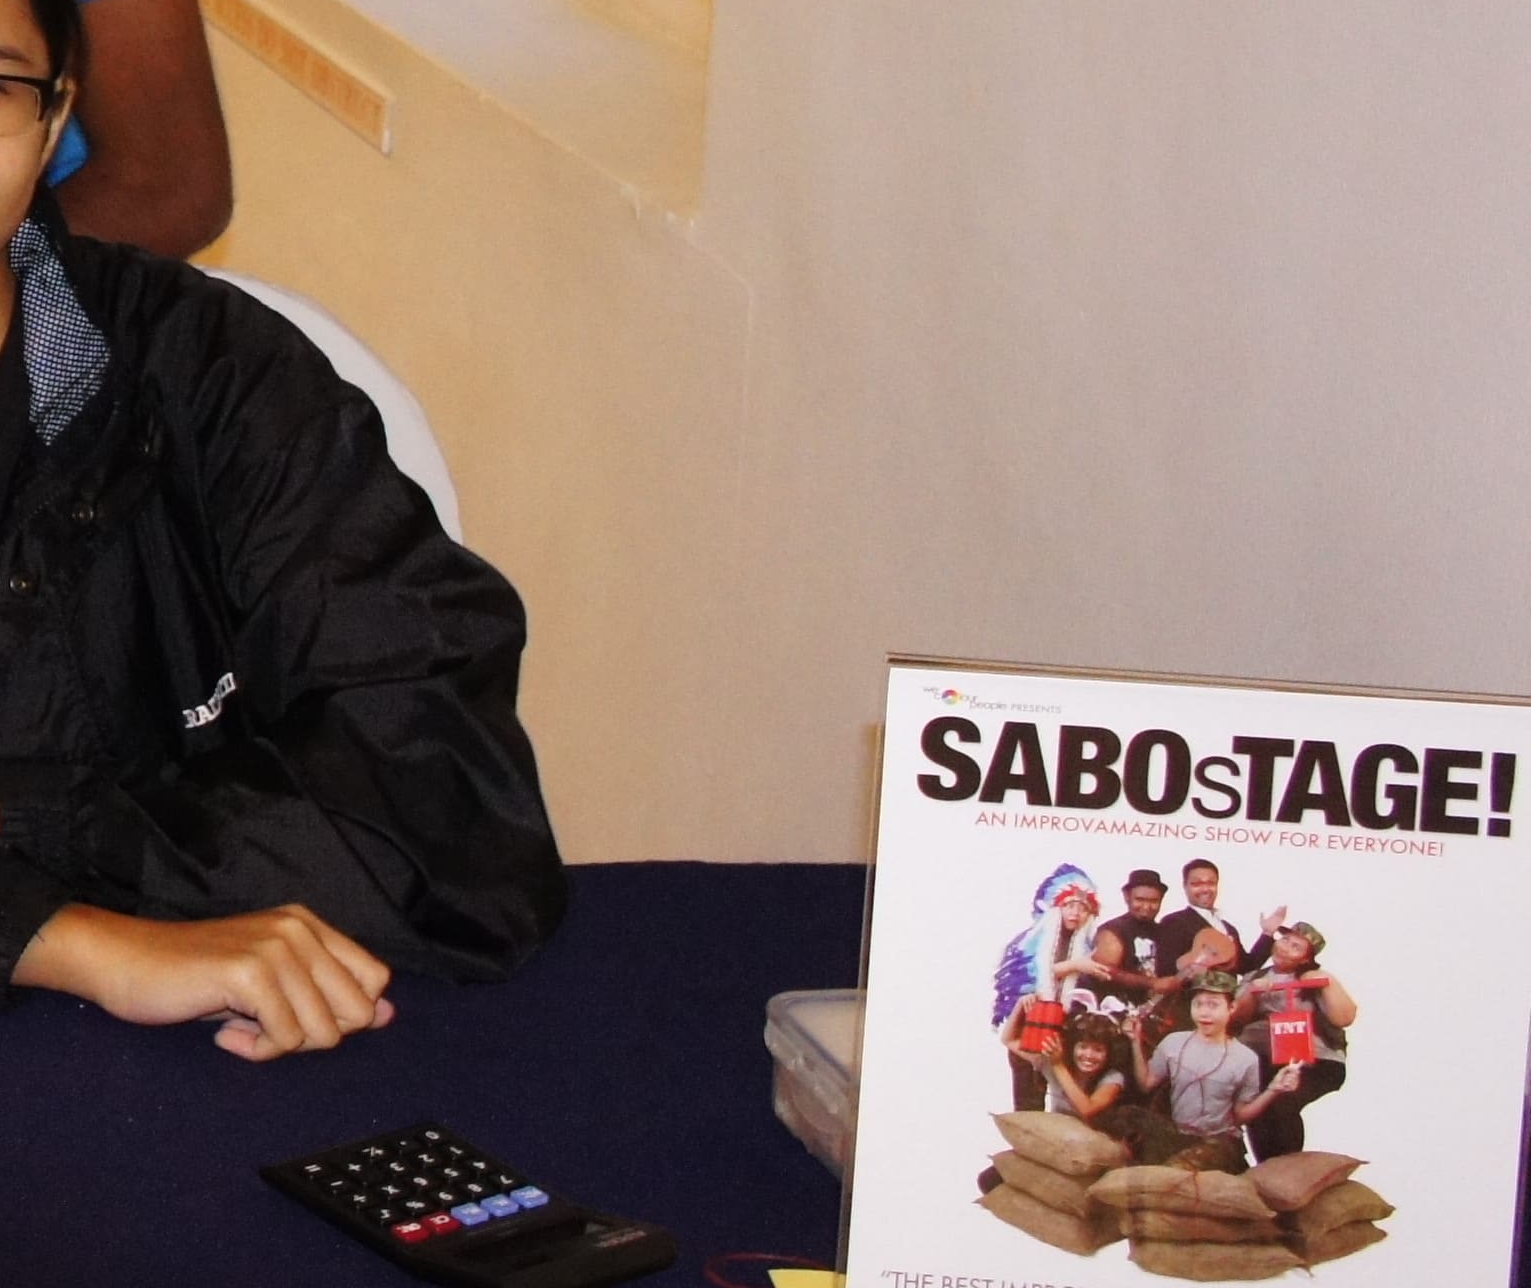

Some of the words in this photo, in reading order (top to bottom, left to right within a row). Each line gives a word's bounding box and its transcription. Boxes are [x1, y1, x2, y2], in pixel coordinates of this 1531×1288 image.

[975, 811, 1006, 827] AN
[1013, 813, 1197, 841] IMPROVAMAZING
[1205, 825, 1272, 845] SHOW
[1280, 831, 1319, 849] FOR
[1327, 835, 1444, 858] EVERYONE!
[1274, 1021, 1307, 1035] TNT
